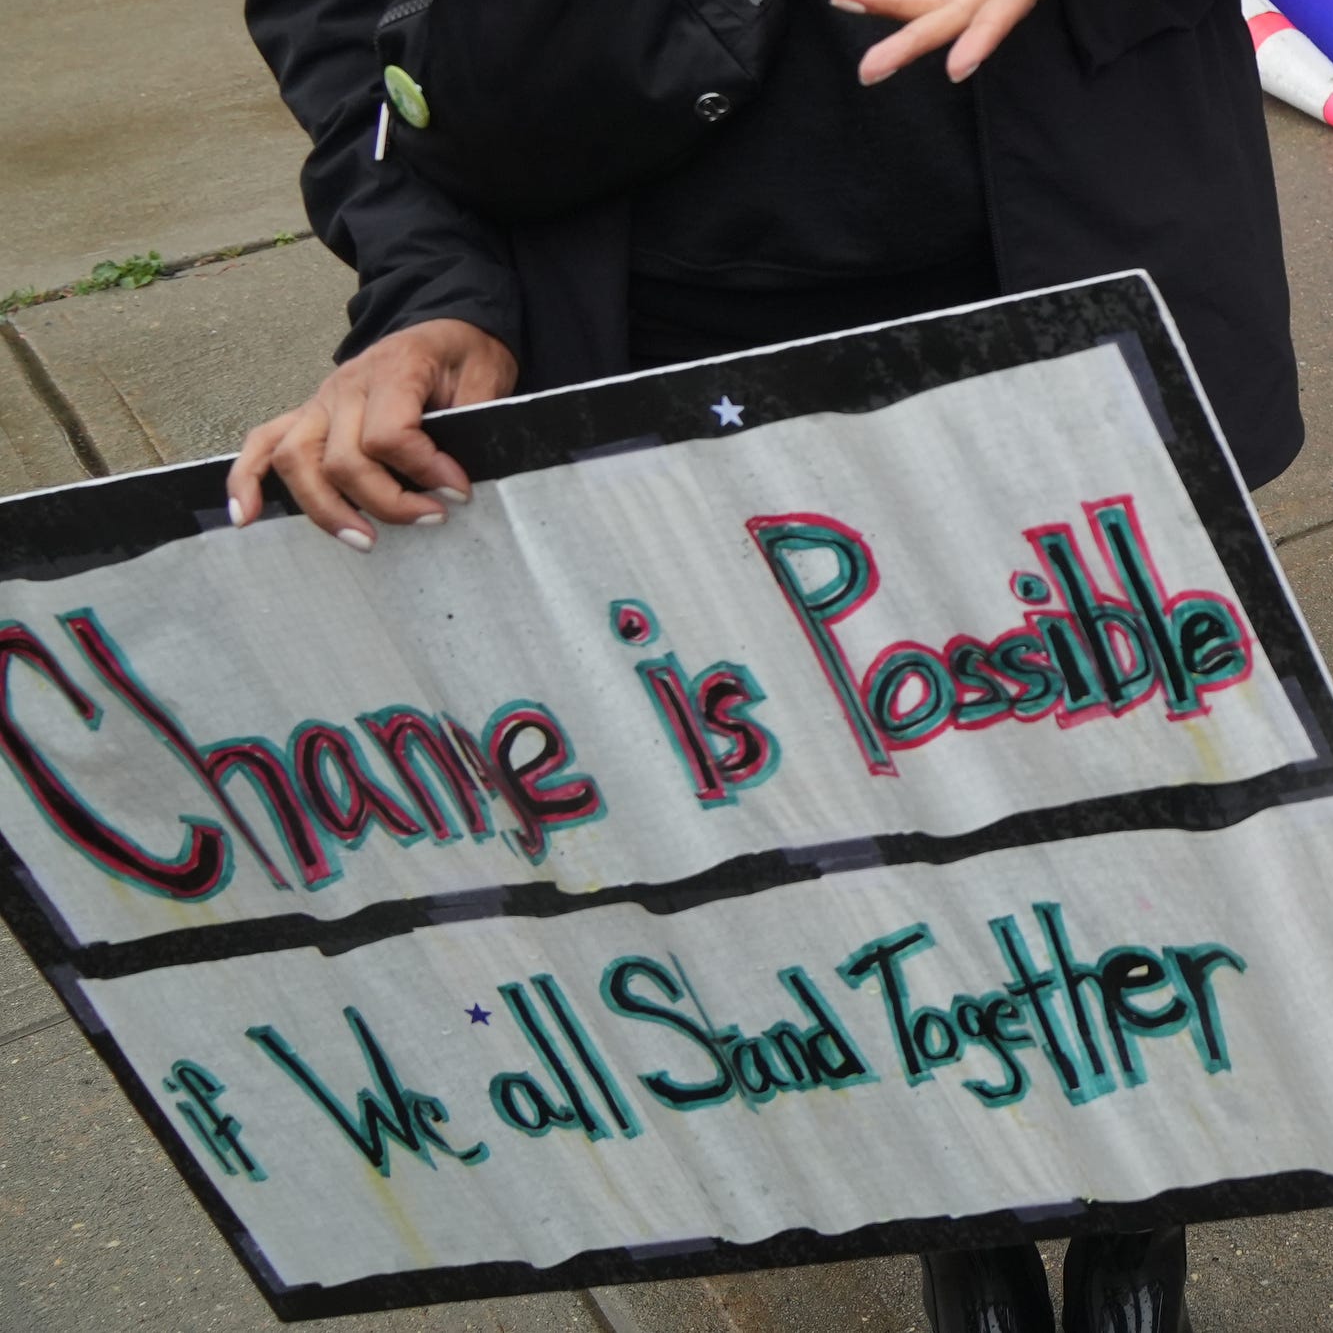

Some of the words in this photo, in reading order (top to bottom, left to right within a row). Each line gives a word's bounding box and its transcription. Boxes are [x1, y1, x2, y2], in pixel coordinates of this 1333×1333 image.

[610, 598, 782, 809] is
[746, 494, 1253, 777] Possible
[162, 1059, 268, 1182] if
[489, 973, 645, 1140] all
[837, 901, 1247, 1108] Together
